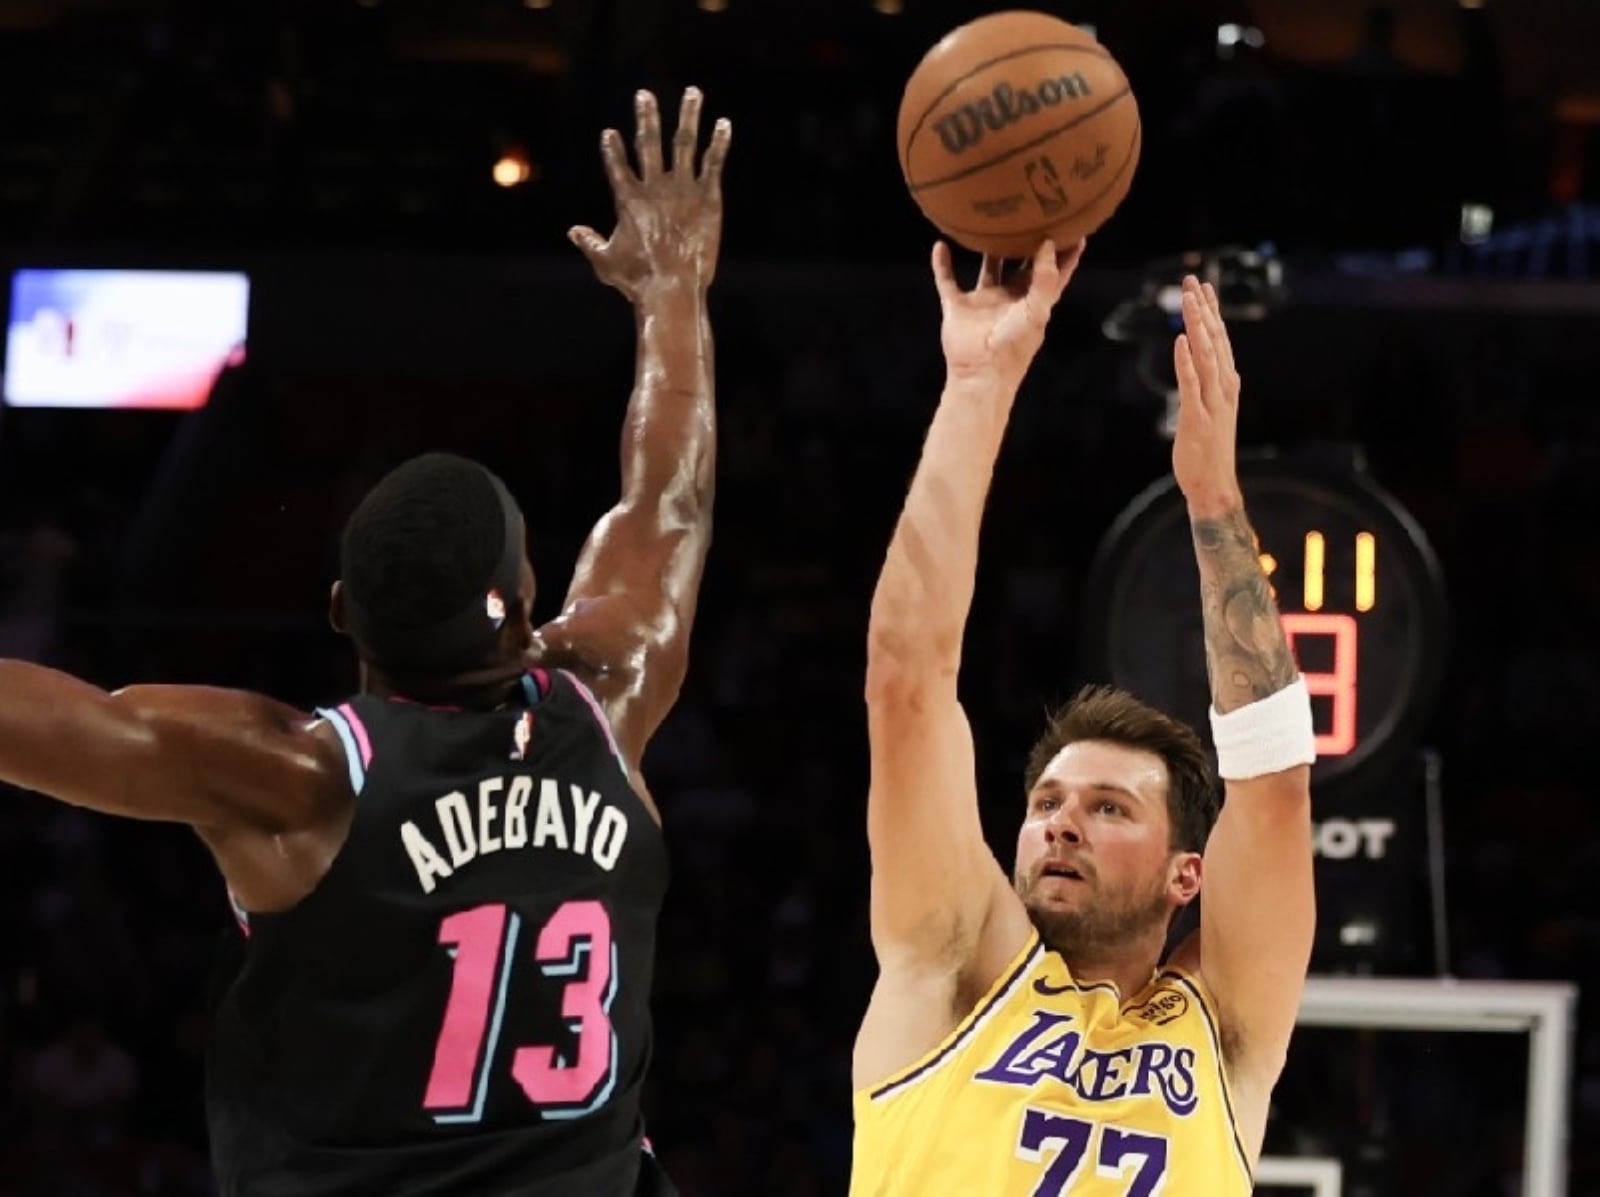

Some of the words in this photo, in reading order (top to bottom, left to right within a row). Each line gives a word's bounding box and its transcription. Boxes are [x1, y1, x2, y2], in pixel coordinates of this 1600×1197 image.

[933, 69, 1092, 155] Wilson
[400, 775, 629, 895] ADEBAYO
[1312, 816, 1397, 860] OT
[423, 900, 618, 1124] 13
[1016, 1106, 1169, 1197] 77
